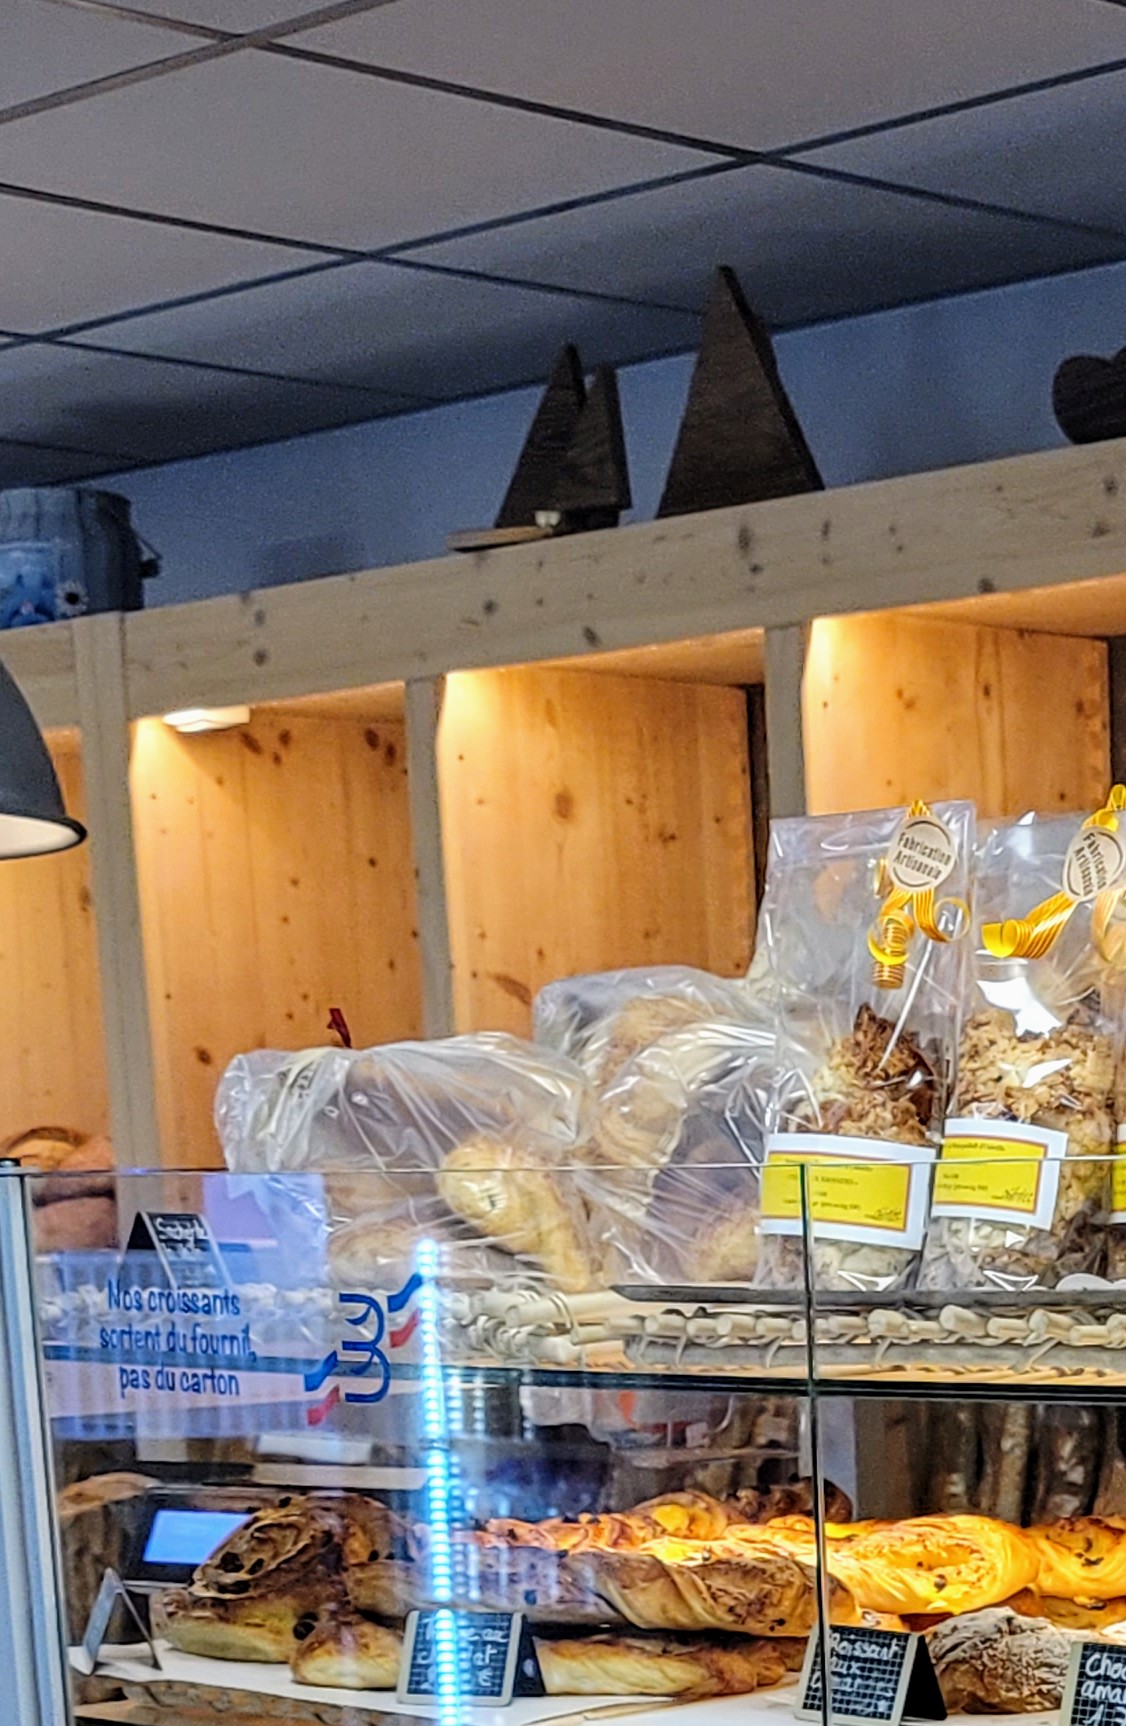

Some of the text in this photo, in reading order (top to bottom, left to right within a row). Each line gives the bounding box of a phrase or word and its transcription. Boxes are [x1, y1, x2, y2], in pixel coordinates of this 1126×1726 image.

[108, 1279, 240, 1316] Nos croissants
[100, 1325, 161, 1351] sortent
[167, 1323, 188, 1353] du
[119, 1362, 240, 1397] pas du carton
